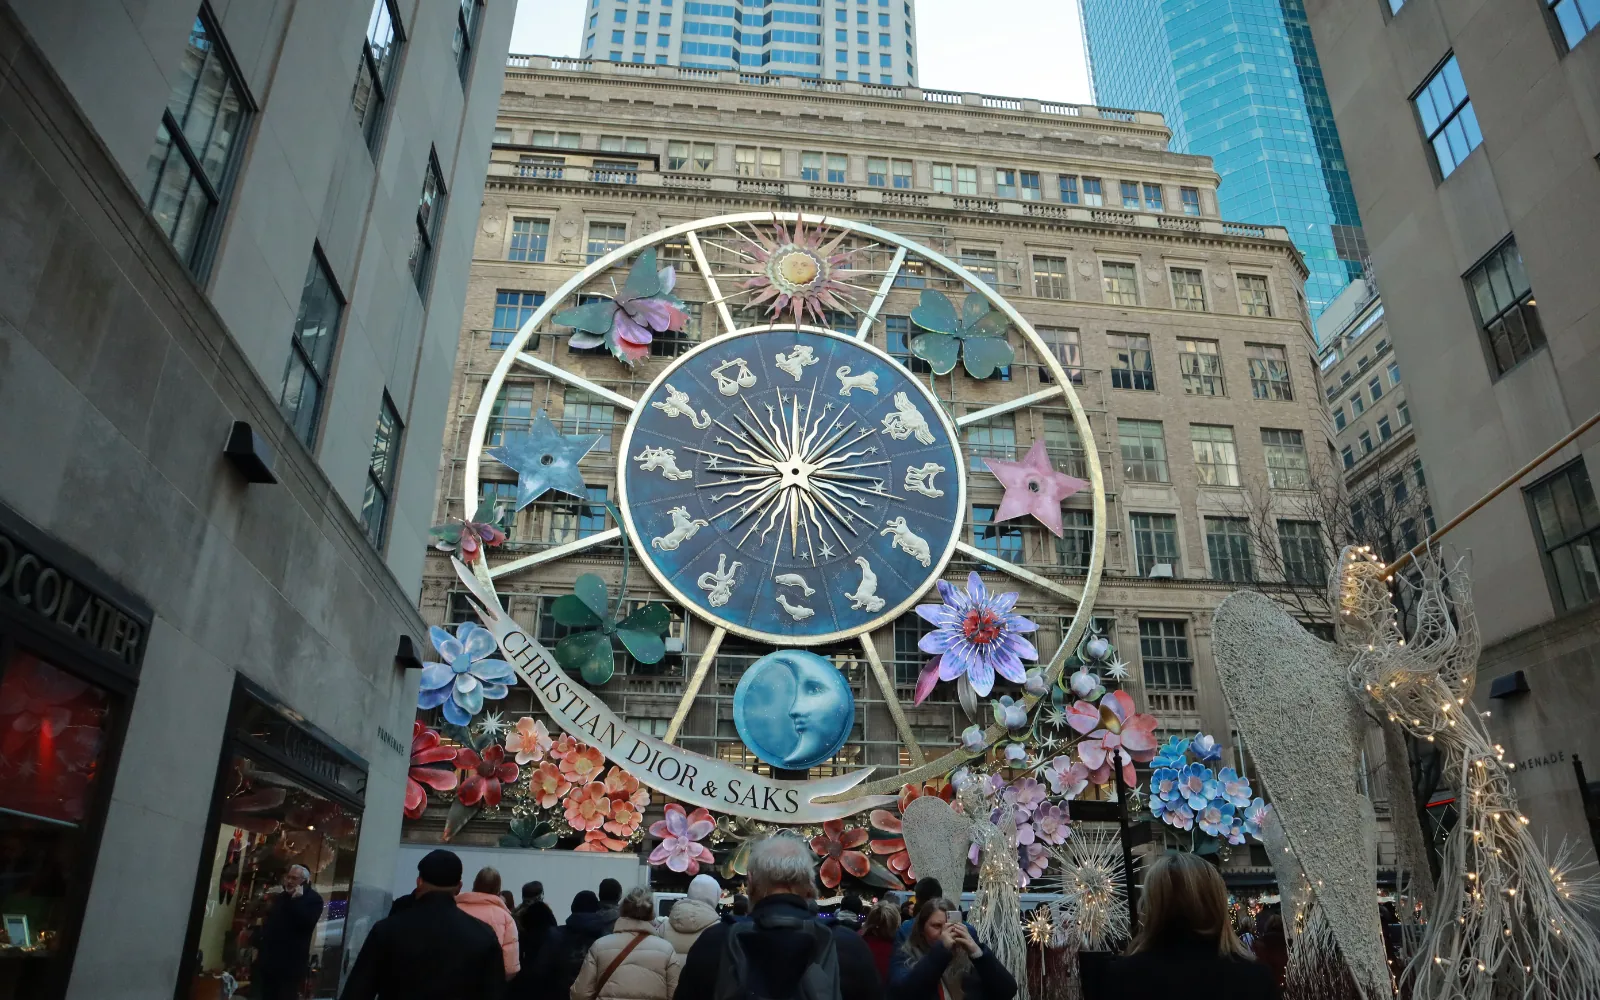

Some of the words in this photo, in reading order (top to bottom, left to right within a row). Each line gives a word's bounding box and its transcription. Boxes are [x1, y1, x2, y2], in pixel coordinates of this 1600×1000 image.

[377, 725, 405, 757] PROMENADE
[502, 631, 626, 749] CHRISTIAN
[625, 739, 698, 792] DIOR
[701, 780, 718, 798] &
[723, 779, 799, 814] SAKS
